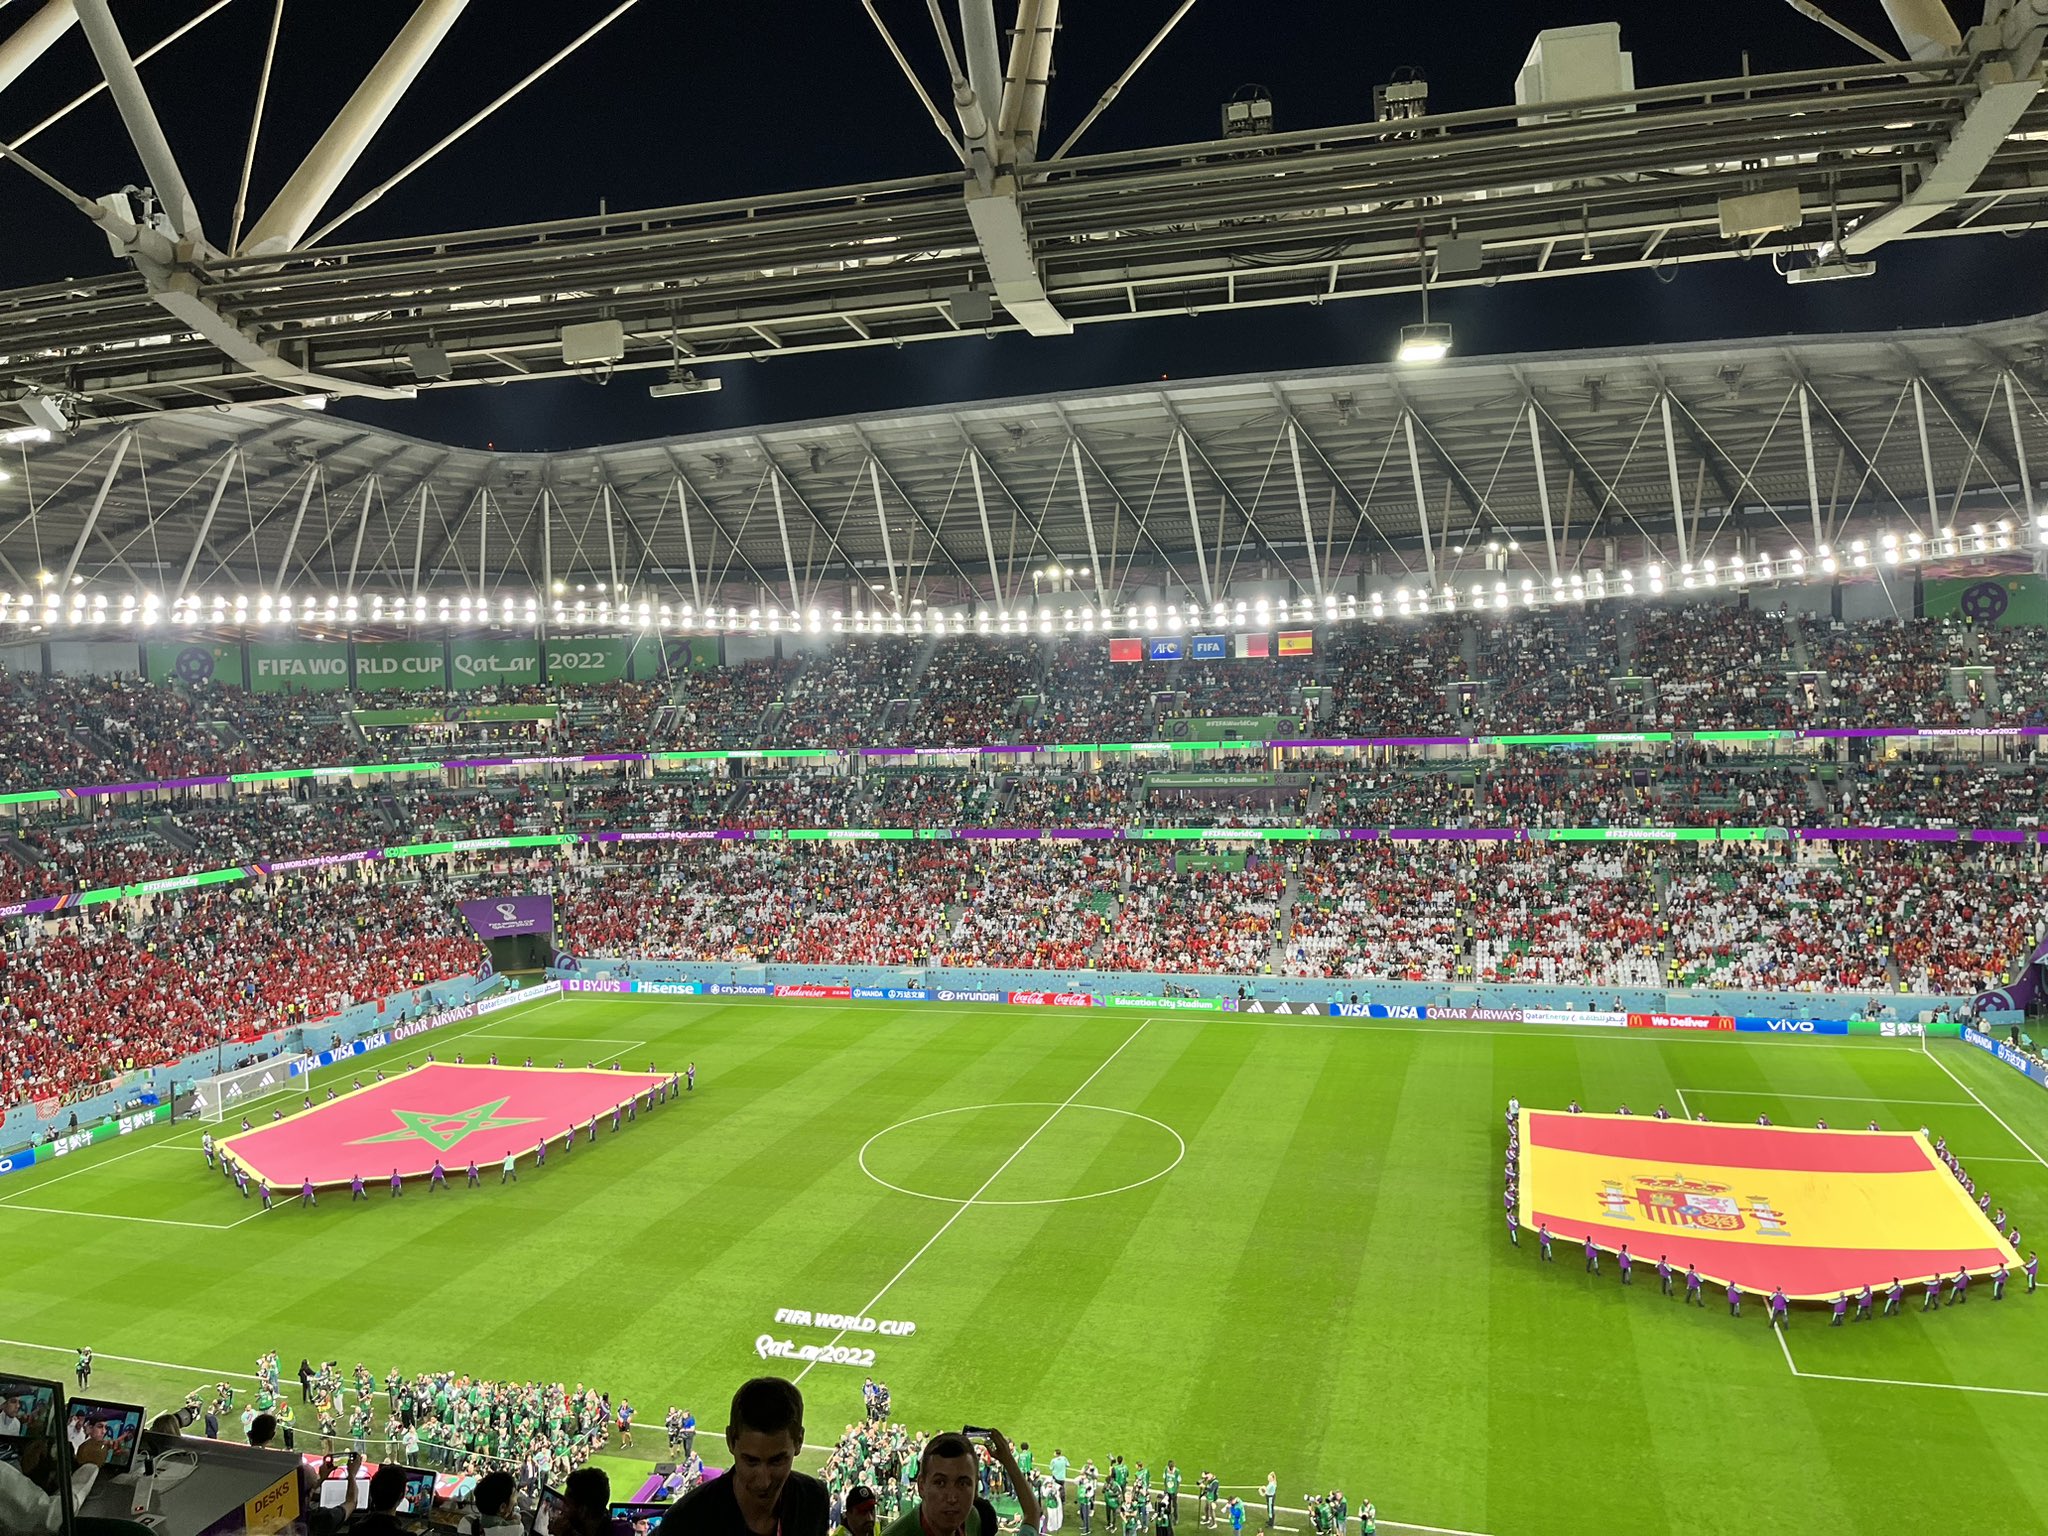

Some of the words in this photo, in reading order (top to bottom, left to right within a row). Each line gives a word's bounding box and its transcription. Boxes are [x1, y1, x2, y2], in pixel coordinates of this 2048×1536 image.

[1197, 643, 1220, 652] FIFA
[258, 658, 305, 676] FIFA
[308, 657, 397, 675] WORLD
[402, 656, 443, 674] CUP
[455, 655, 535, 677] Qatar
[1214, 776, 1228, 784] City
[1202, 831, 1263, 839] #FIFAWorldCup
[1605, 830, 1677, 840] #FIFAWorldCup
[271, 862, 284, 871] FIFA
[285, 859, 307, 870] WORLD
[308, 858, 320, 867] CUP
[583, 980, 620, 992] BYJU'S
[637, 981, 694, 994] Hisense
[776, 985, 826, 997] Budweiser
[956, 992, 999, 1001] HYUNDAI
[1013, 992, 1045, 1004] Coca-Cola
[1054, 993, 1087, 1006] Coca-Cola
[479, 995, 516, 1012] QatarEnergy
[1115, 998, 1157, 1007] Education
[1159, 999, 1175, 1009] City
[1177, 1000, 1212, 1009] Stadium
[1337, 1003, 1371, 1017] VISA
[1386, 1005, 1419, 1018] VISA
[1427, 1008, 1467, 1019] QATAR
[1472, 1009, 1523, 1021] AIRWAYS
[1525, 1012, 1570, 1022] QatarEnergy
[394, 1018, 428, 1040] QATAR
[431, 1004, 473, 1028] AIRWAYS
[1651, 1016, 1669, 1027] We
[1670, 1017, 1709, 1028] Deliver
[363, 1034, 388, 1051] VISA
[330, 1044, 355, 1062] VISA
[296, 1055, 321, 1073] VISA
[774, 1308, 812, 1327] FIFA
[814, 1312, 877, 1333] WORLD
[878, 1319, 917, 1337] CUP
[254, 1481, 290, 1514] DESKS
